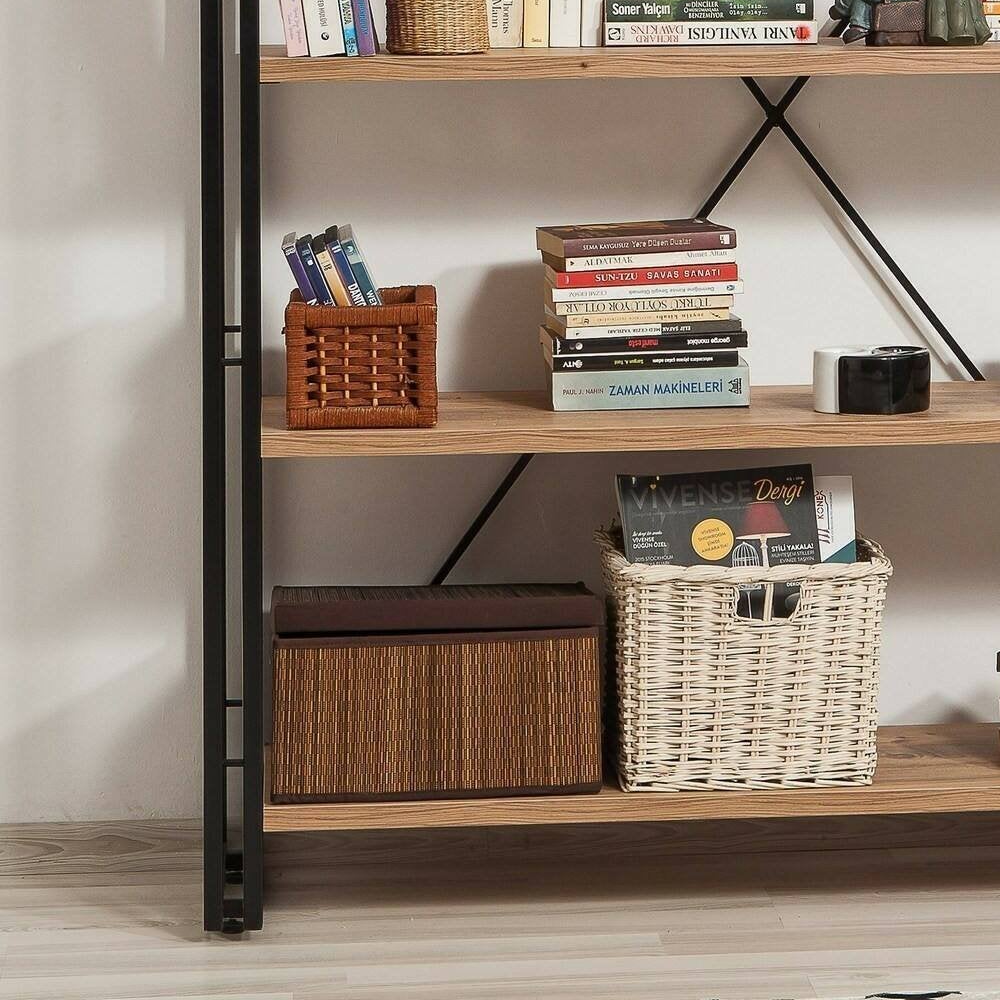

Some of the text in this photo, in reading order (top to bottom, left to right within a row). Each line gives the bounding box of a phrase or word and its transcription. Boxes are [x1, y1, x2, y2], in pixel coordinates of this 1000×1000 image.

[612, 2, 671, 18] Soner Yalçın
[691, 0, 719, 8] DİNCİLER
[631, 24, 684, 35] DAWKINS
[688, 26, 806, 40] TANRI YANILGISI
[599, 242, 629, 250] KAYGUSUZ
[584, 256, 633, 267] ALDATMAK
[595, 269, 721, 282] SUN-TZU SANATI
[565, 297, 711, 313] TÜRKÜ SÖYLÜYOR OTLAR
[628, 339, 659, 347] manifesto
[609, 378, 723, 396] ZAMAN MAKİNELERİ
[754, 479, 805, 505] Dergi
